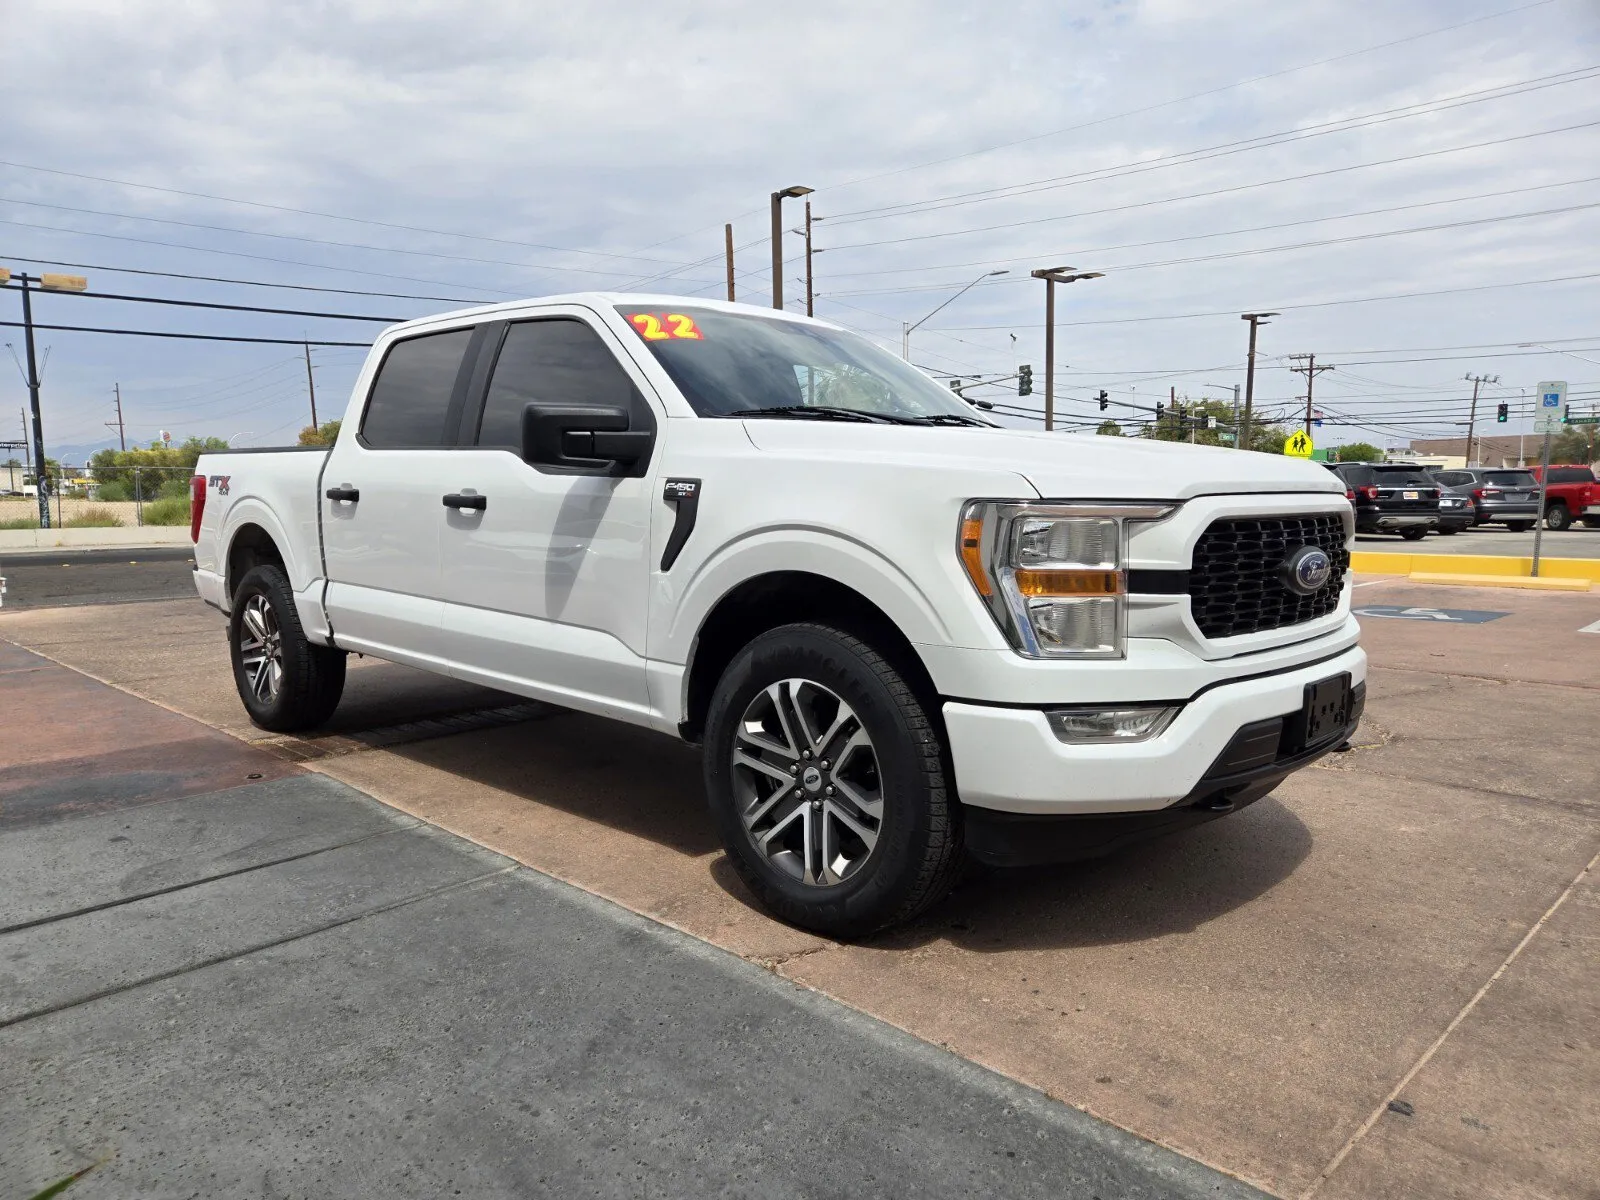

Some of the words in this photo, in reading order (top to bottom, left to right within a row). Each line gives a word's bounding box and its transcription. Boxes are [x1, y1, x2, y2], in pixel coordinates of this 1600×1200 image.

[633, 314, 699, 339] 22
[208, 475, 231, 491] STX
[666, 482, 695, 491] F-150
[1307, 560, 1329, 581] Ford
